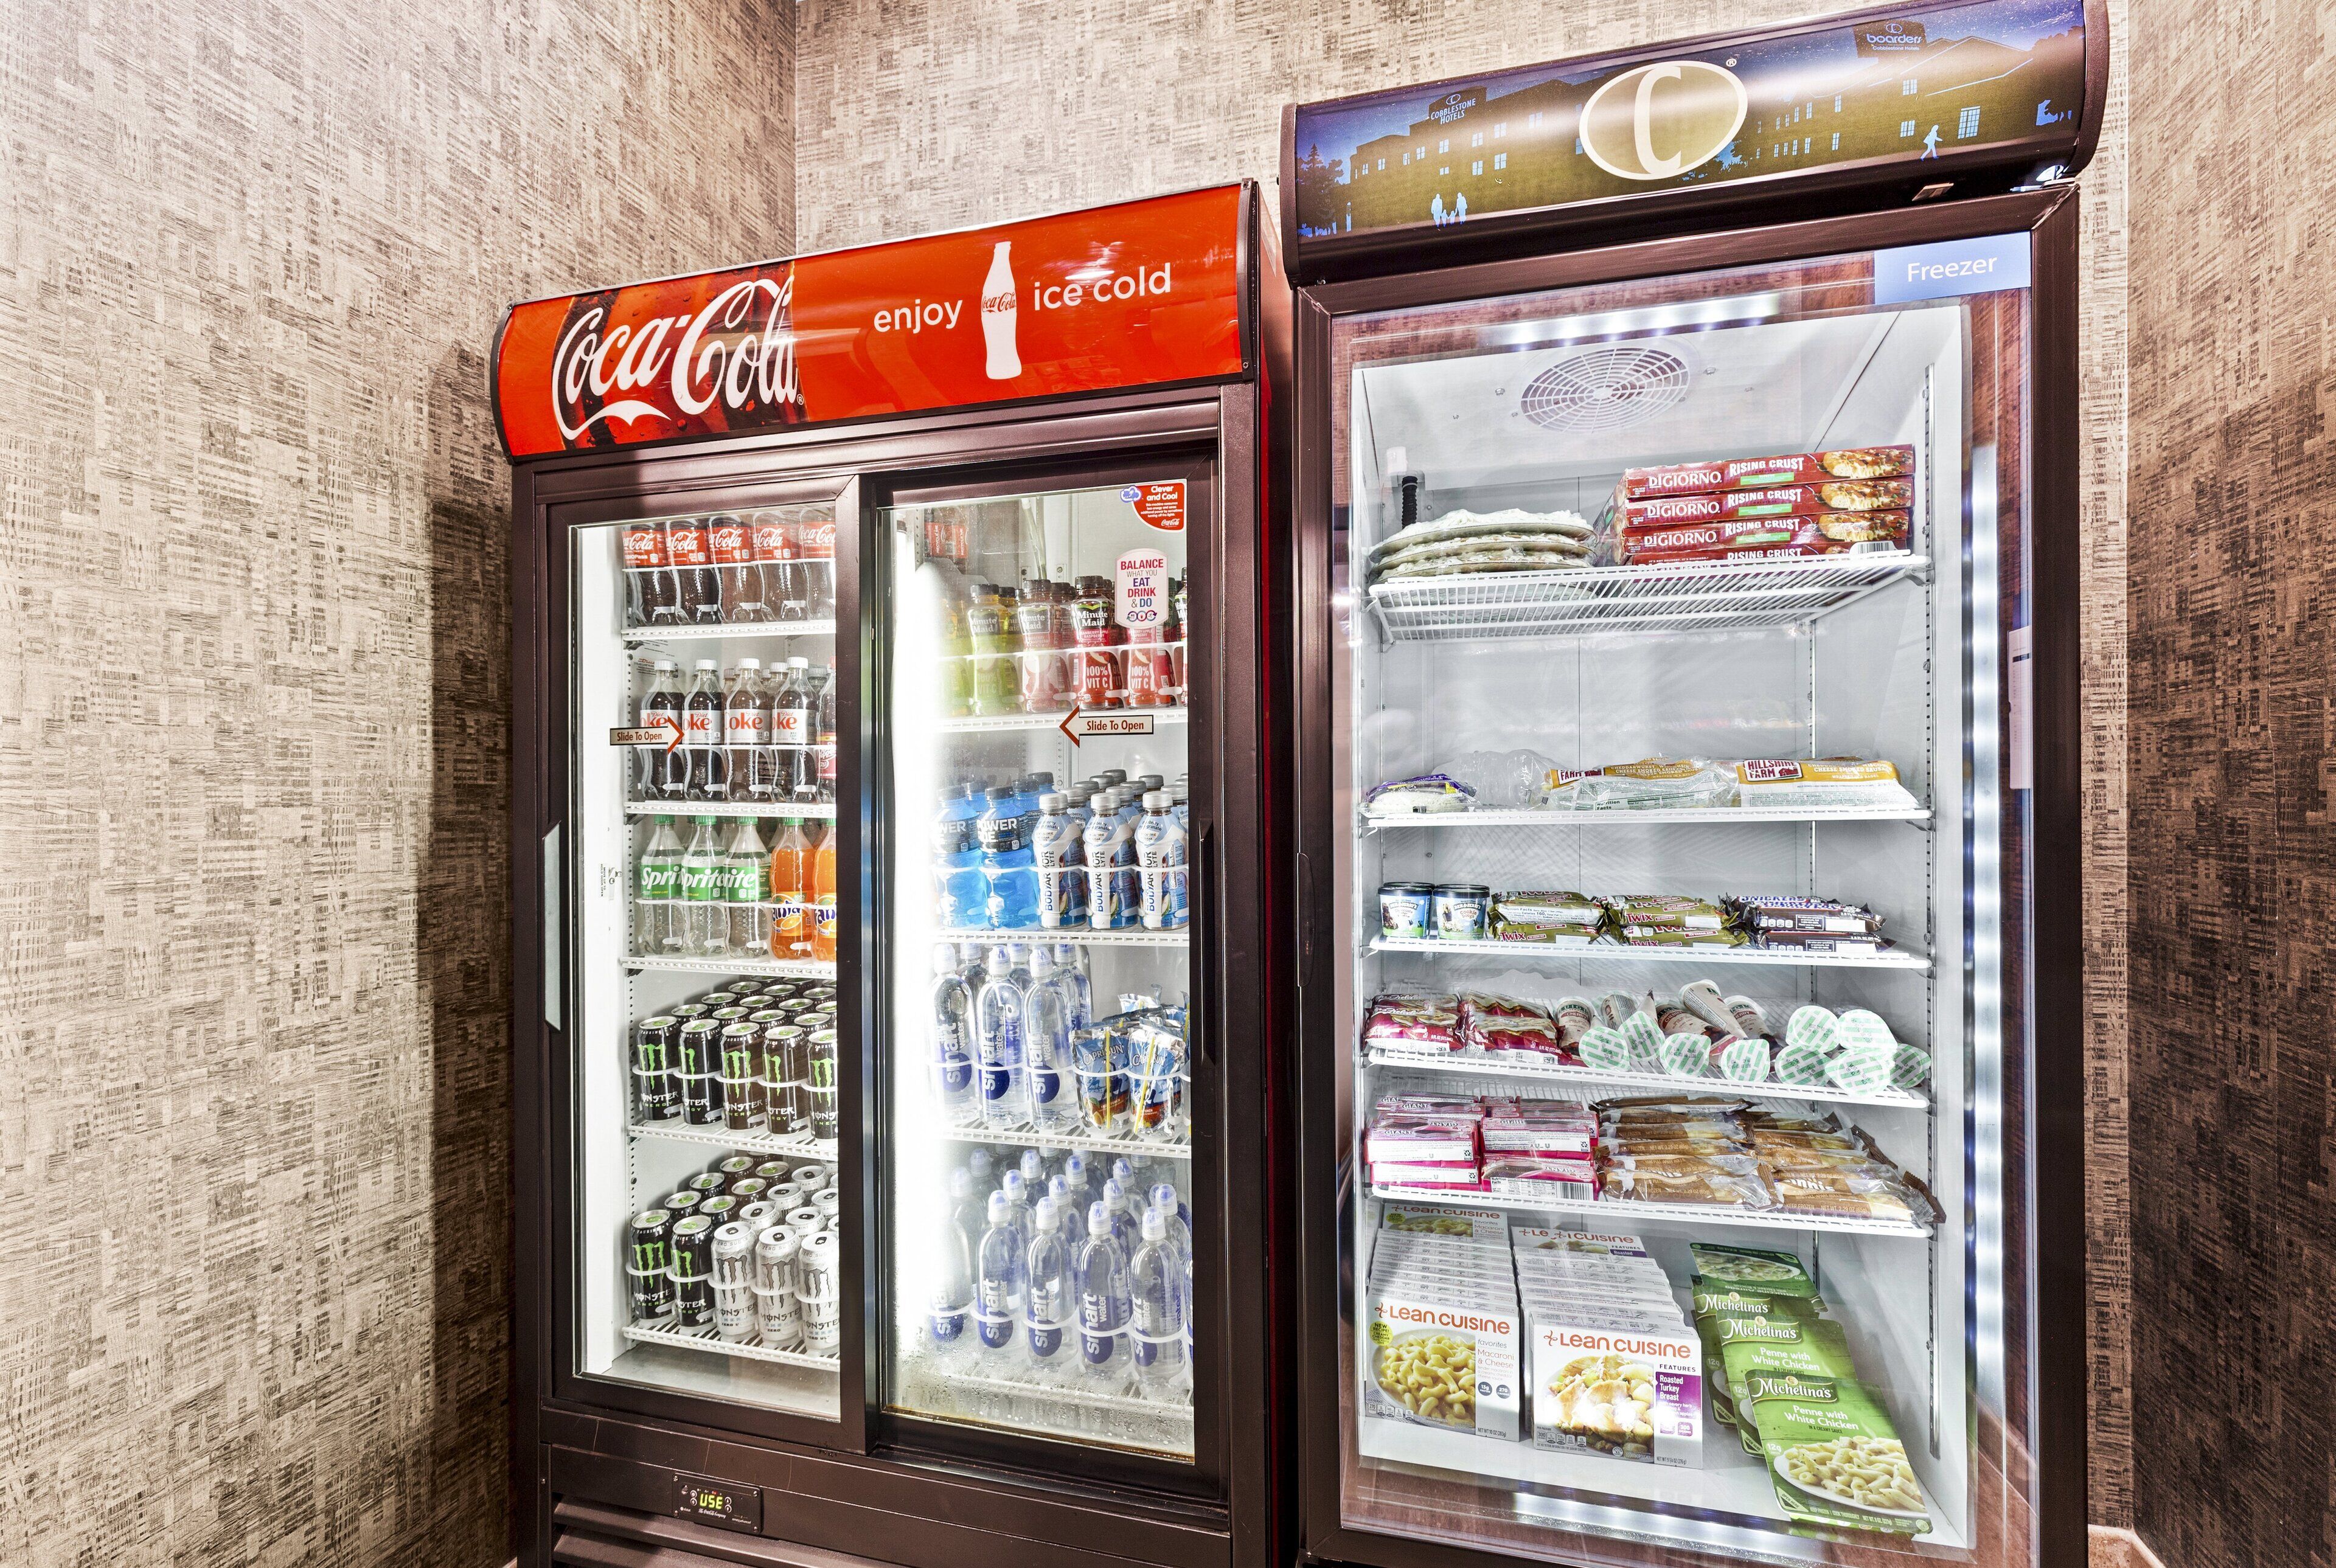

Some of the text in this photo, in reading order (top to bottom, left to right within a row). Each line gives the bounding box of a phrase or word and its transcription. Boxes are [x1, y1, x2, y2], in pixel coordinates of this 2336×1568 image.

[1866, 33, 1922, 43] boarders
[1431, 98, 1476, 120] COBBLESTONE
[1441, 109, 1465, 125] HOTELS
[1634, 64, 1682, 174] C
[1907, 255, 1997, 282] Freezer
[1035, 262, 1170, 311] ice cold
[982, 292, 1017, 313] Coca-Cola
[874, 296, 963, 334] enjoy
[552, 272, 799, 440] Coca-Cola
[1729, 458, 1804, 477] RISING CRUST
[1728, 489, 1802, 507] RISING CRUST
[1725, 519, 1799, 537] RISING CRUST
[1767, 548, 1802, 557] CRUST
[1121, 559, 1164, 570] BALANCE
[1128, 588, 1156, 597] DRINK
[1132, 598, 1152, 608] & DO
[1086, 666, 1108, 676] 100%
[1132, 666, 1149, 676] 100%
[1087, 678, 1108, 689] VIT C
[1132, 678, 1141, 689] VIT
[1087, 720, 1144, 732] Slide To Open
[617, 731, 662, 742] Slide To Open
[1749, 768, 1776, 779] FARM
[1042, 1034, 1052, 1061] water
[1099, 1295, 1107, 1322] water
[1697, 1294, 1768, 1313] Michelina's
[1142, 1300, 1150, 1327] water
[1390, 1305, 1435, 1324] Lean
[1722, 1319, 1797, 1339] Michelina's
[1478, 1339, 1507, 1348] favorites
[1560, 1333, 1610, 1350] Lean
[1478, 1348, 1514, 1360] Macaroni
[1759, 1347, 1810, 1361] Penne with
[1485, 1358, 1514, 1369] Cheese
[1708, 1358, 1720, 1367] 12g
[1751, 1355, 1820, 1371] White Chicken
[1660, 1375, 1683, 1384] Roasted
[1660, 1383, 1679, 1394] Turkey
[1734, 1386, 1747, 1395] 12g
[1751, 1378, 1832, 1398] Michelina's
[1660, 1392, 1679, 1401] Breast
[1793, 1404, 1848, 1420] Penne with
[1784, 1412, 1859, 1430] White Chicken
[1752, 1443, 1761, 1451] HERE
[1767, 1443, 1781, 1454] 12g
[700, 1493, 723, 1510] USE
[1790, 1500, 1800, 1508] HERE
